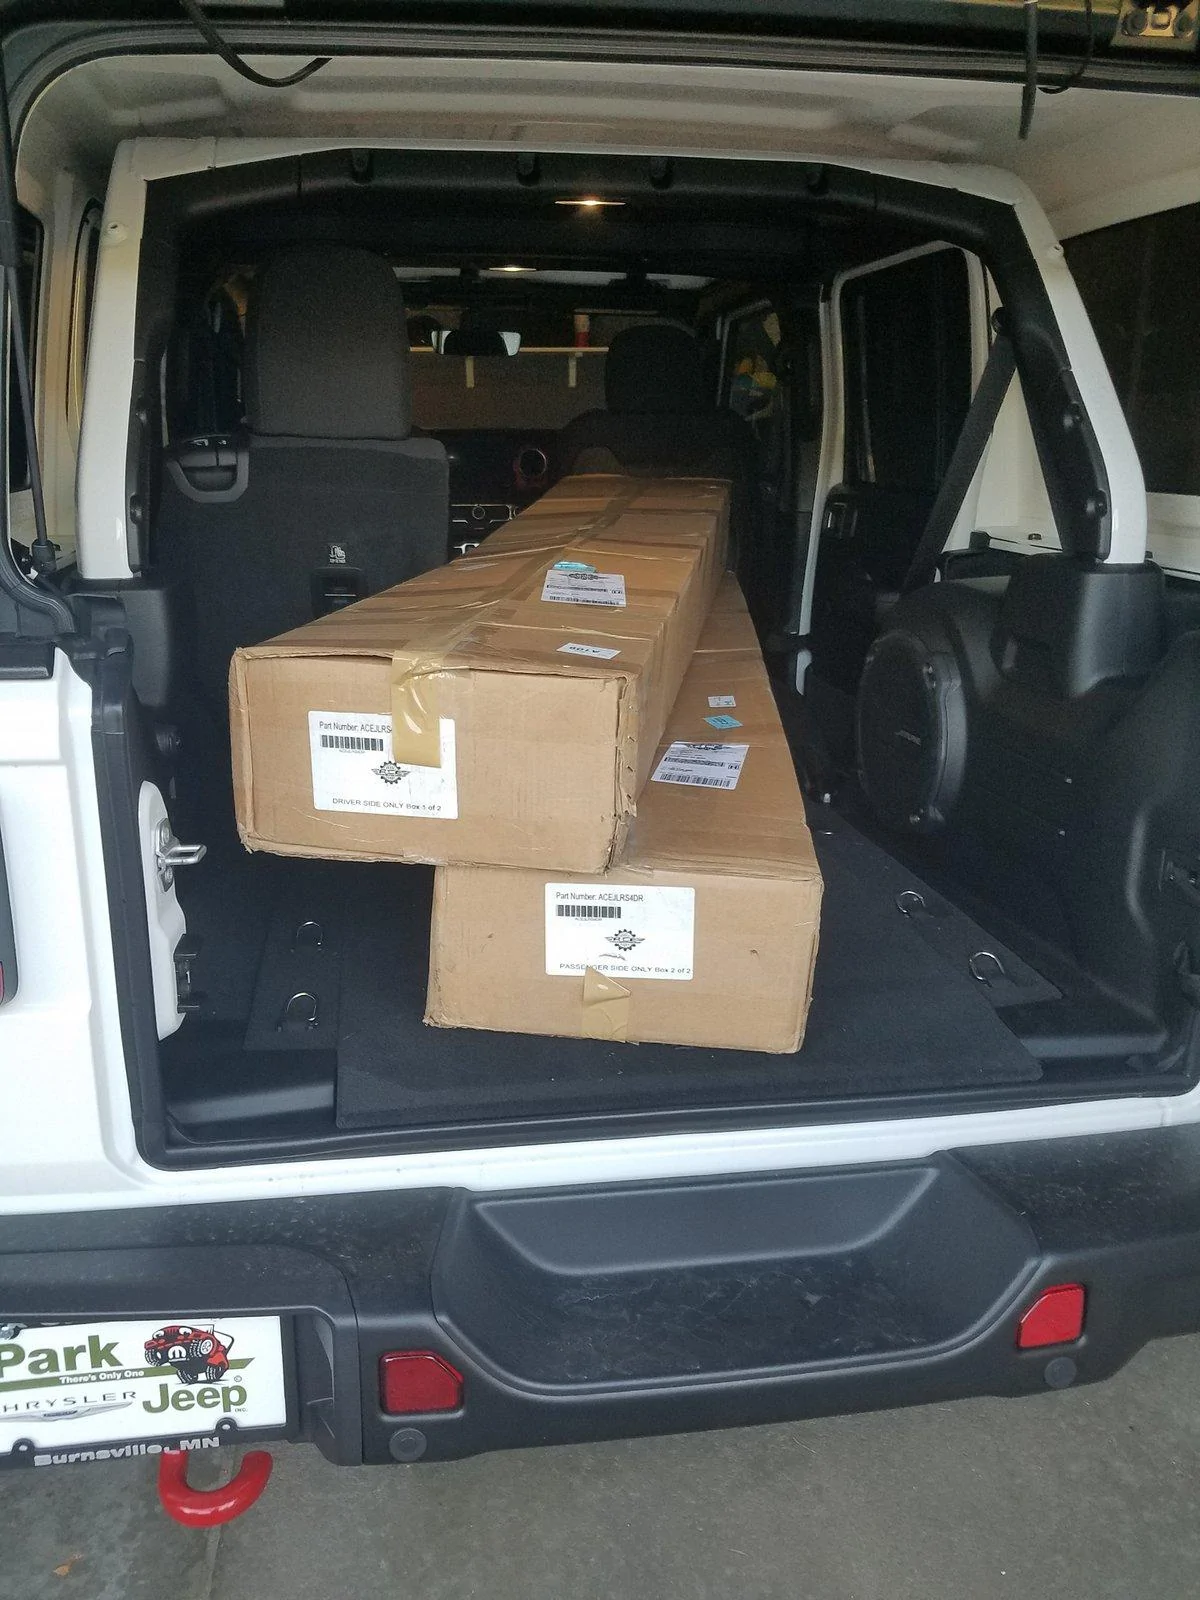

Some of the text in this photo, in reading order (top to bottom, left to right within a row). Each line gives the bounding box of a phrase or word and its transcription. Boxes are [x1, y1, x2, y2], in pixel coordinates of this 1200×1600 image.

[319, 721, 333, 730] Part
[360, 724, 393, 734] ACEJLRS
[332, 797, 361, 806] DRIVER
[383, 801, 404, 809] ONLY
[556, 891, 569, 900] Part
[610, 964, 629, 972] SIDE
[631, 965, 653, 973] ONLY
[0, 1335, 123, 1377] Park
[59, 1370, 144, 1384] There's Only One
[0, 1391, 136, 1414] HRYSLER
[142, 1383, 247, 1413] Jeep
[180, 1437, 220, 1450] MN
